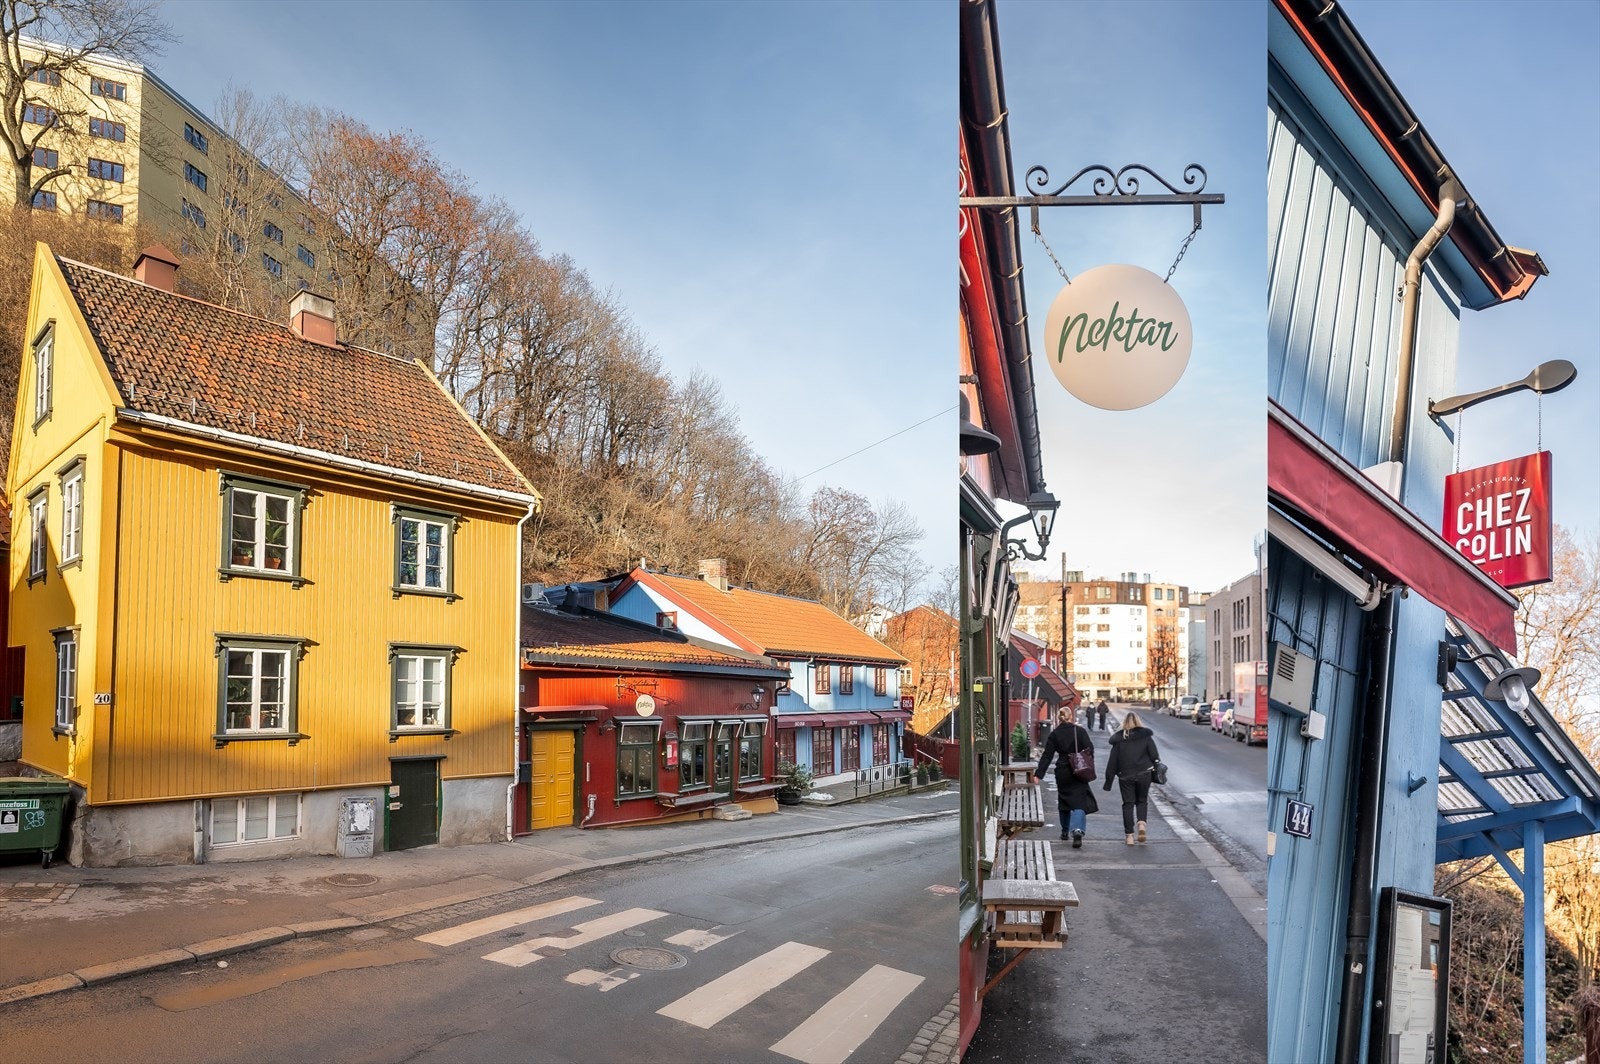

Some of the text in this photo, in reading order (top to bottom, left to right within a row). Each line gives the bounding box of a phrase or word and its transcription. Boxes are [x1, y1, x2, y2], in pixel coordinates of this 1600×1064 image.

[1464, 476, 1526, 497] RESTAURANT
[1456, 487, 1532, 536] CHEZ
[1488, 569, 1503, 577] SLO
[95, 694, 110, 704] 40
[1291, 804, 1311, 834] 44
